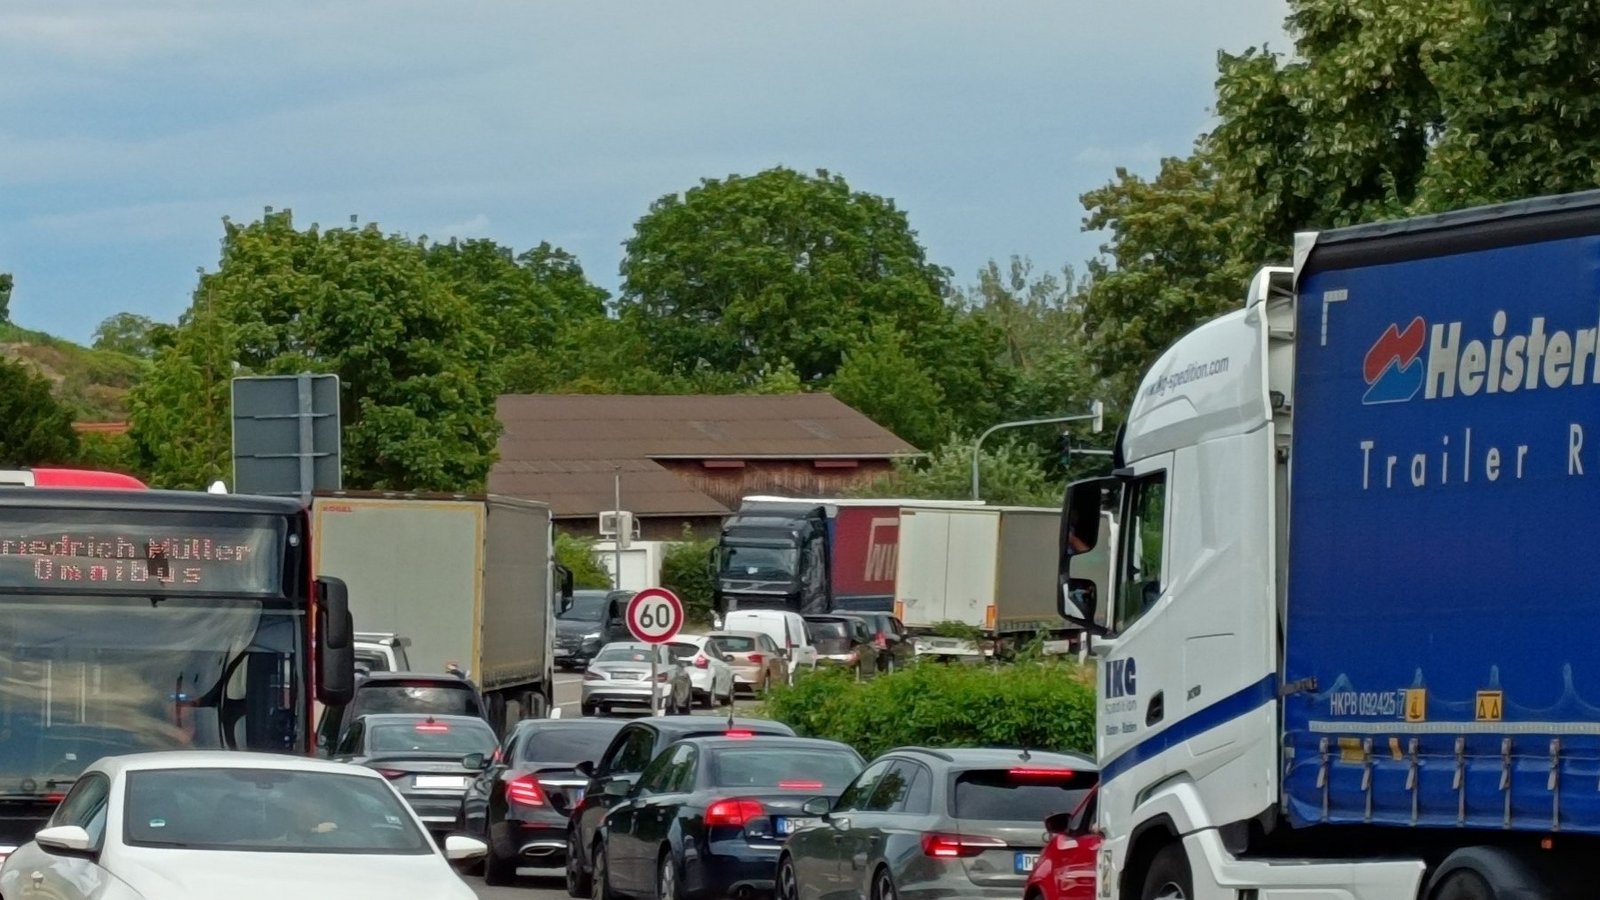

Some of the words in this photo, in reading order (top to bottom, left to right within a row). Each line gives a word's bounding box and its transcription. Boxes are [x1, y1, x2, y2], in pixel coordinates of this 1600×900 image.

[1360, 427, 1528, 489] Trailer
[1569, 423, 1584, 475] R
[149, 537, 252, 560] Müller
[34, 558, 201, 583] Omnibus
[640, 603, 670, 629] 60
[1105, 657, 1136, 699] IKG
[1330, 692, 1357, 715] HKPB
[1359, 692, 1396, 716] 092425
